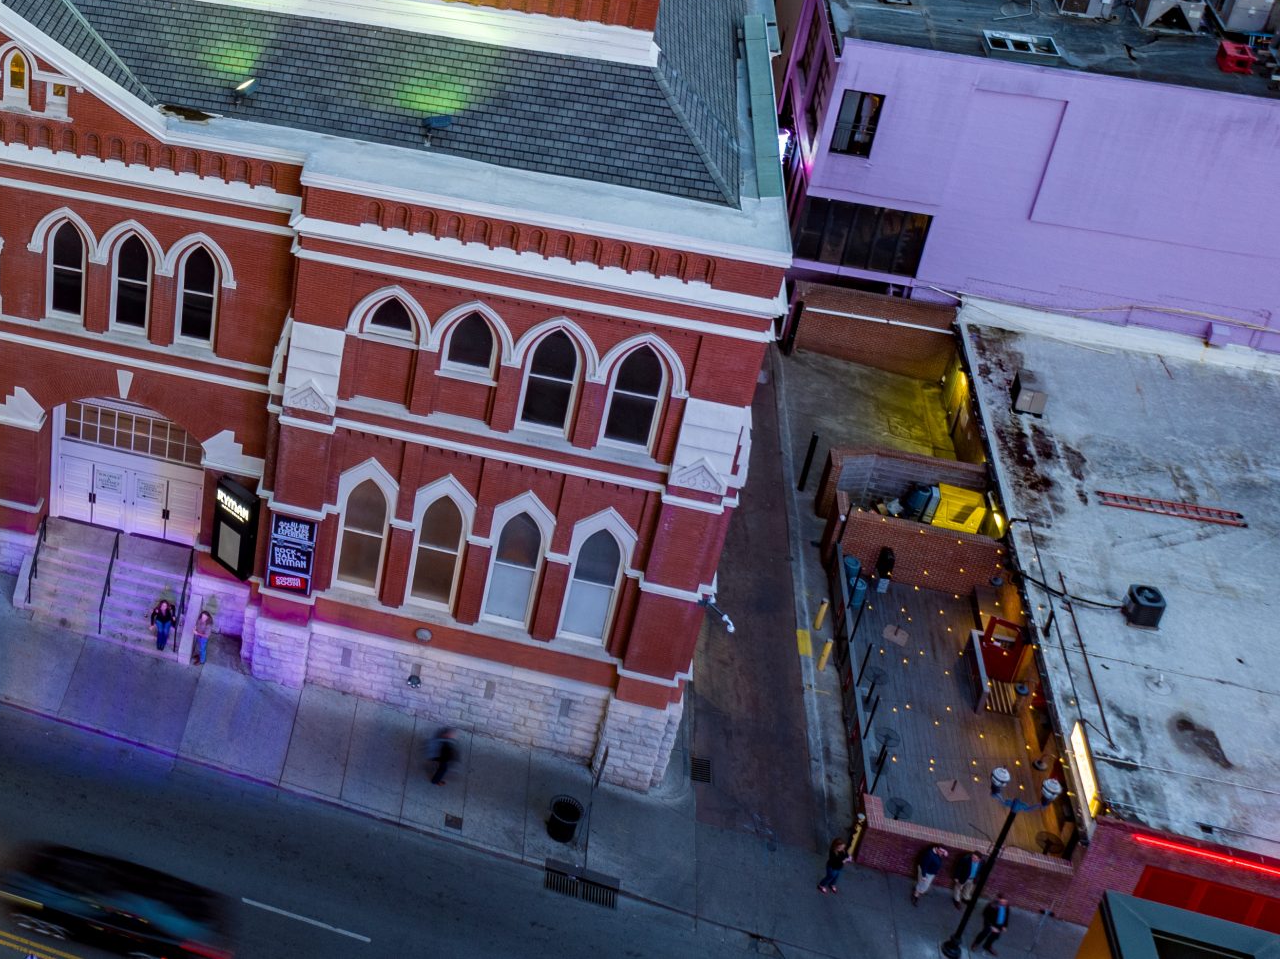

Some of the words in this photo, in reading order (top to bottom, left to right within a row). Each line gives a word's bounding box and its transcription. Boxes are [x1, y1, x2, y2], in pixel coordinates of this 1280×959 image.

[216, 488, 249, 522] RYMAN
[274, 546, 296, 555] ROCK
[275, 551, 297, 560] HALL
[275, 557, 307, 569] RYMAN
